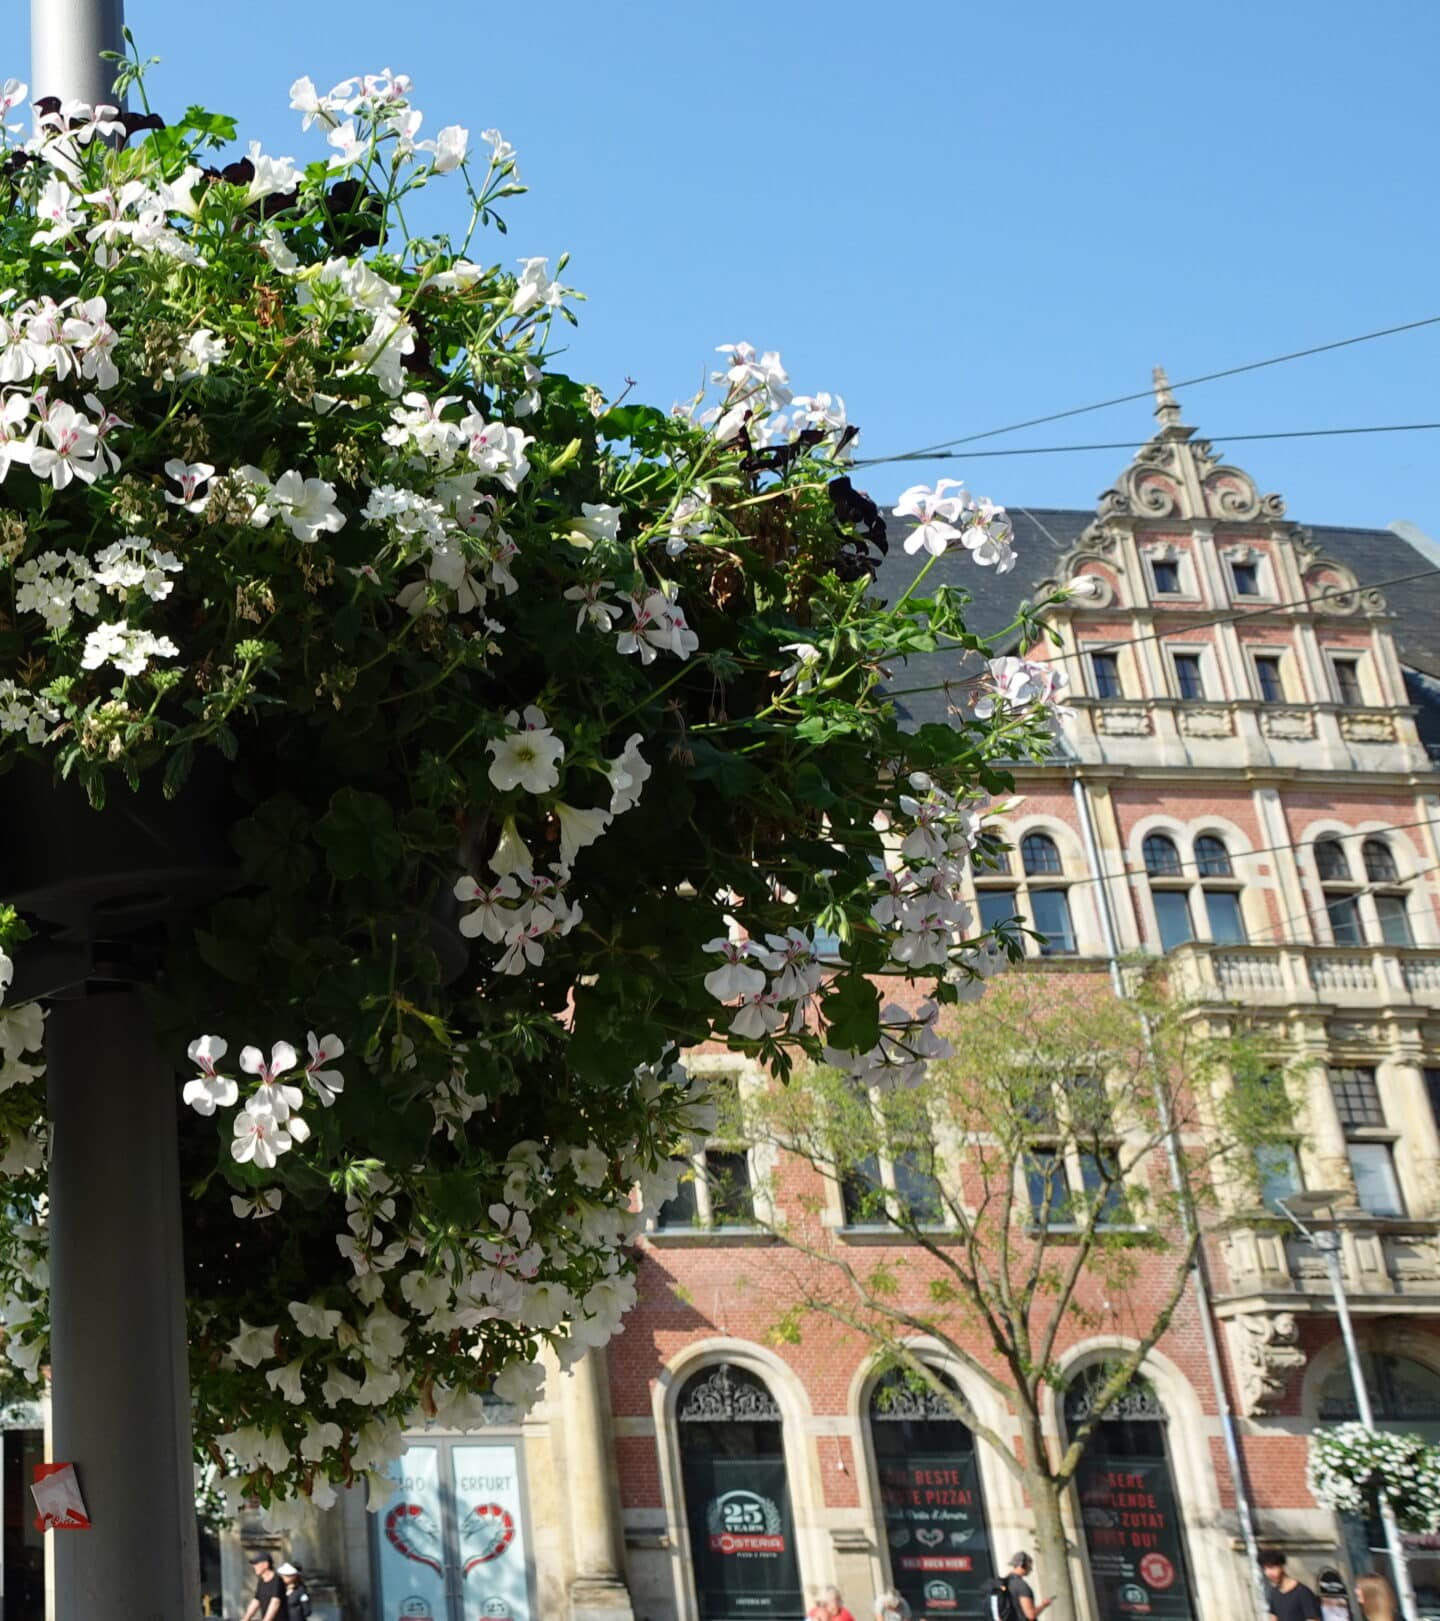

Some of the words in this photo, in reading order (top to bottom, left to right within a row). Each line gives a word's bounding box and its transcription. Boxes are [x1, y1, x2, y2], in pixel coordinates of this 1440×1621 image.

[461, 1476, 512, 1491] ERFURT
[914, 1470, 960, 1485] BESTE
[925, 1489, 972, 1504] PIZZA!
[1084, 1490, 1158, 1509] LENDE
[724, 1504, 763, 1524] 25
[1121, 1512, 1165, 1528] ZUTAT
[725, 1524, 765, 1533] YEARS
[1131, 1531, 1157, 1548] DU!
